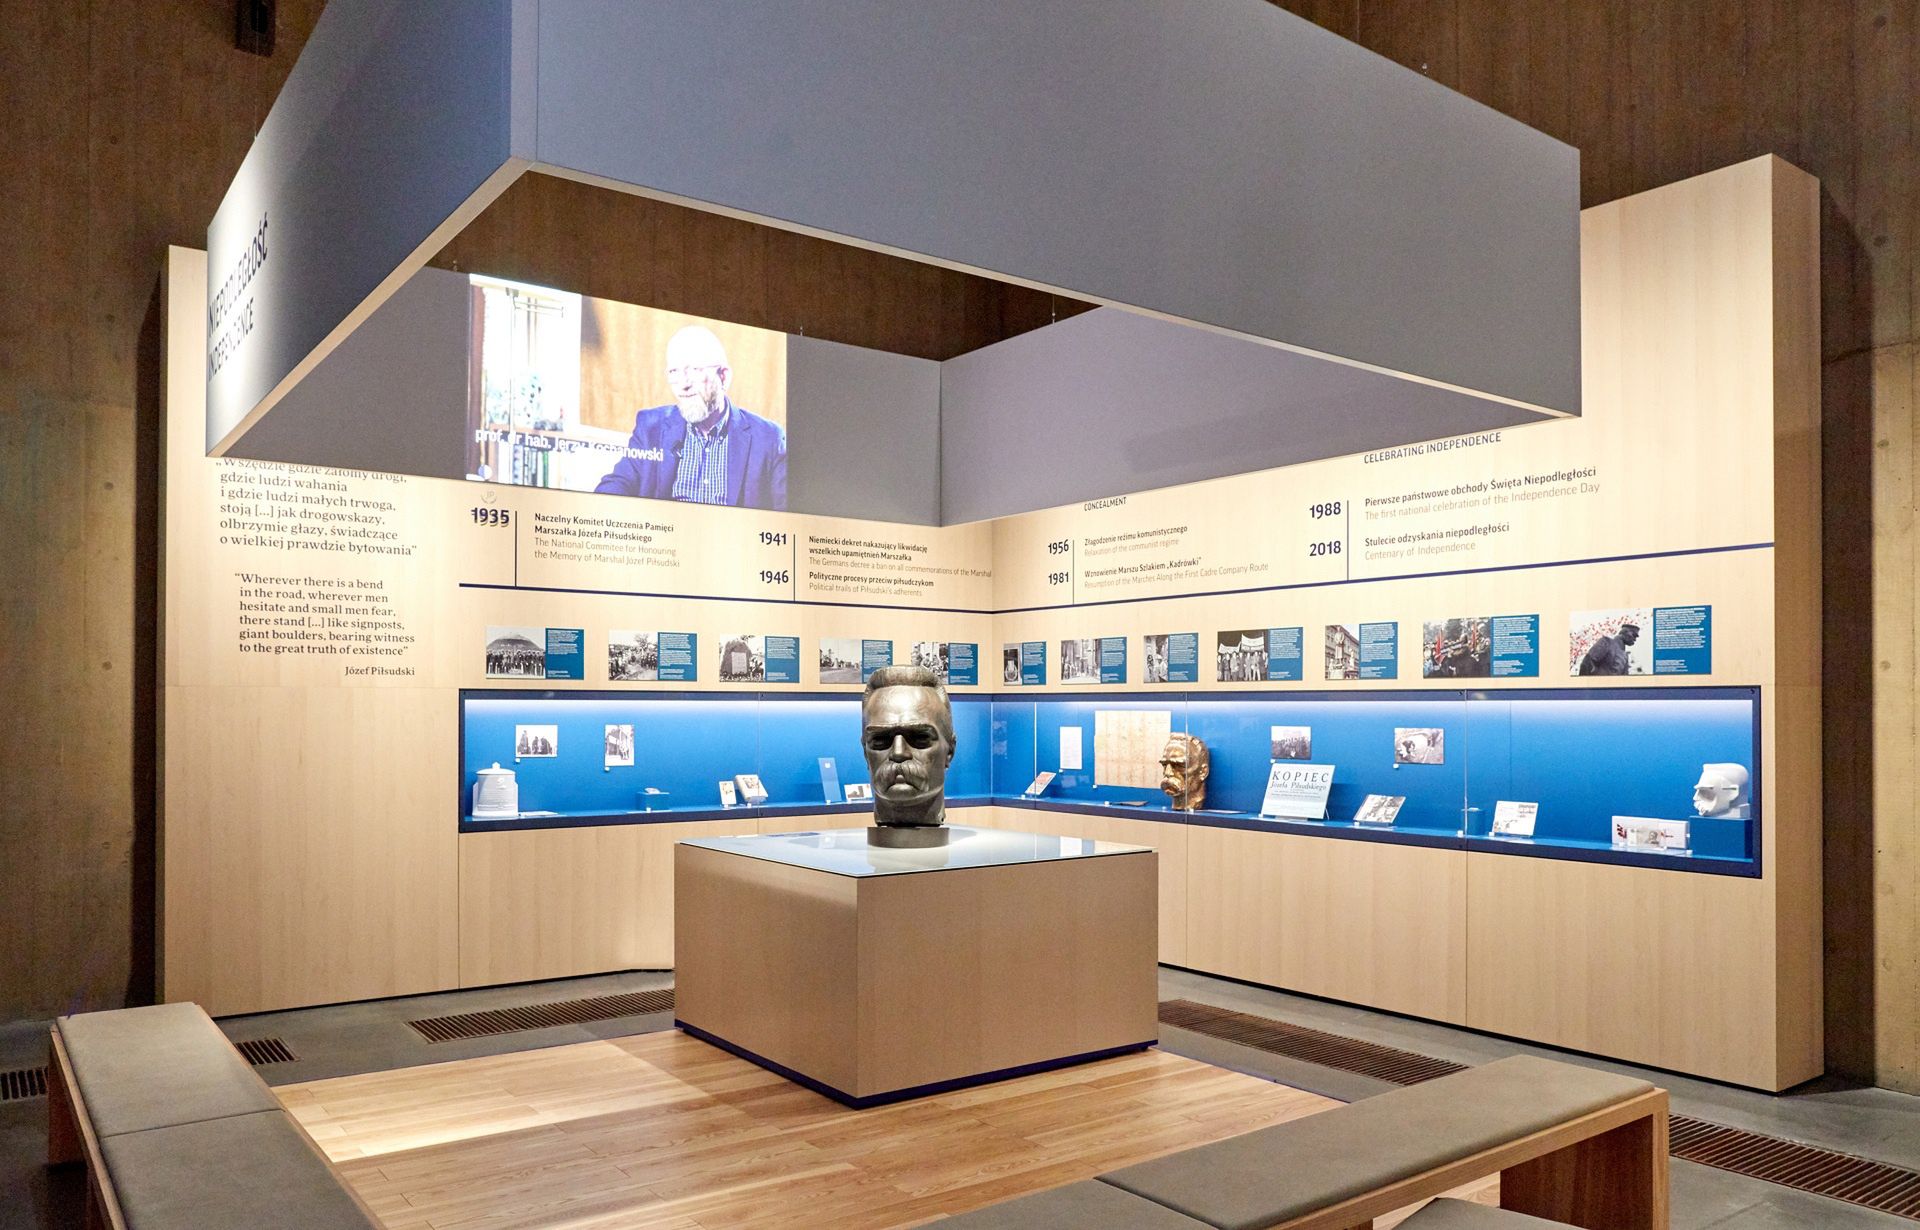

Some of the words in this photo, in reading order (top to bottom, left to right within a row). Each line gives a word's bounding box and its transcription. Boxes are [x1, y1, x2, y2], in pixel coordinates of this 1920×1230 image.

[475, 430, 504, 443] prof.
[507, 433, 521, 445] dr
[525, 435, 551, 449] hab.
[554, 437, 585, 453] Jerzy
[1364, 445, 1425, 464] CELEBRATING
[1427, 432, 1502, 453] INDEPENDENCE
[220, 472, 255, 485] gdzie
[258, 474, 291, 488] ludzi
[294, 478, 347, 493] wahania
[1365, 496, 1401, 507] Pierwsze
[1402, 489, 1450, 503] państwowe
[1451, 482, 1488, 496] obchody
[1491, 478, 1522, 491] Święta
[1525, 466, 1597, 486] Niepodległości
[220, 486, 225, 497] i
[228, 487, 262, 500] gdzie
[266, 490, 298, 504] ludzi
[302, 493, 347, 508] małych
[350, 498, 397, 512] trwoga,
[1084, 497, 1127, 511] CONCEALMENT
[1365, 510, 1379, 520] The
[1381, 508, 1397, 518] first
[1398, 503, 1431, 516] national
[1433, 497, 1480, 512] celebration
[1482, 496, 1492, 506] of
[1494, 493, 1509, 504] the
[1511, 485, 1577, 502] Independence
[1581, 482, 1600, 497] Day
[220, 503, 251, 516] stoją
[276, 507, 296, 519] jak
[300, 508, 385, 527] drogowskazy,
[471, 507, 510, 525] 1935
[1309, 501, 1342, 519] 1988
[220, 518, 288, 534] olbrzymie
[290, 523, 328, 537] głazy,
[330, 526, 398, 543] świadczące
[534, 513, 571, 525] Naczelny
[573, 516, 604, 528] Komitet
[606, 519, 643, 531] Uczczenia
[645, 523, 674, 534] Pamięci
[534, 525, 577, 538] Marszałka
[578, 528, 602, 541] Józefa
[604, 530, 653, 544] Piłsudskiego
[759, 531, 787, 546] 1941
[1084, 535, 1116, 547] Złagodzenie
[1117, 533, 1136, 542] reżimu
[1137, 526, 1188, 539] komunistycznego
[1365, 536, 1396, 547] Stulecie
[1397, 528, 1443, 544] odzyskania
[1445, 521, 1510, 539] niepodległości
[220, 536, 228, 544] o
[231, 535, 284, 550] wielkiej
[287, 541, 345, 553] prawdzie
[534, 538, 549, 548] The
[551, 540, 584, 551] National
[625, 544, 637, 554] for
[638, 546, 676, 559] Honouring
[809, 535, 840, 547] Niemiecki
[841, 538, 862, 548] dekret
[863, 540, 896, 552] nakazujący
[897, 542, 928, 553] likwidację
[1048, 539, 1070, 554] 1956
[1309, 540, 1342, 556] 2018
[1365, 548, 1404, 561] Centenary
[1406, 545, 1415, 556] of
[1417, 541, 1476, 555] Independence
[534, 550, 547, 560] the
[549, 551, 582, 563] Memory
[584, 554, 593, 563] of
[594, 554, 625, 566] Marshal
[626, 556, 645, 569] Józef
[646, 557, 680, 570] Piłsudski
[809, 547, 841, 556] wszelkich
[842, 550, 879, 560] upamiętnień
[881, 552, 912, 561] Marszałka
[810, 556, 820, 565] The
[822, 557, 849, 568] Germans
[850, 560, 870, 570] decree
[877, 562, 888, 570] ban
[954, 568, 960, 576] of
[961, 568, 970, 577] the
[1085, 568, 1117, 578] Wznowienie
[1118, 565, 1138, 574] Marszu
[1139, 562, 1165, 572] Szlakiem
[304, 577, 334, 588] there
[337, 578, 346, 588] is
[356, 579, 383, 590] bend
[759, 570, 789, 584] 1946
[810, 571, 843, 582] Polityczne
[844, 574, 868, 585] procesy
[869, 576, 892, 586] przeciw
[893, 577, 934, 588] piłsudczykom
[1048, 571, 1069, 585] 1981
[240, 587, 251, 597] in
[255, 588, 274, 599] the
[276, 589, 306, 600] road,
[308, 591, 362, 602] wherever
[365, 594, 388, 603] men
[239, 601, 286, 612] hesitate
[288, 603, 309, 614] and
[312, 604, 342, 615] small
[345, 607, 369, 616] men
[371, 606, 396, 618] fear,
[239, 615, 271, 626] there
[273, 616, 305, 627] stand
[327, 618, 349, 629] like
[351, 618, 405, 631] signposts,
[239, 629, 269, 641] giant
[272, 630, 326, 641] boulders,
[329, 631, 372, 643] bearing
[374, 632, 415, 643] witness
[239, 643, 251, 653] to
[254, 643, 272, 653] the
[274, 644, 304, 656] great
[307, 645, 337, 655] truth
[339, 645, 351, 655] of
[344, 666, 370, 677] Józef
[371, 666, 415, 677] Piłsudski
[1272, 771, 1329, 782] KOPIEC
